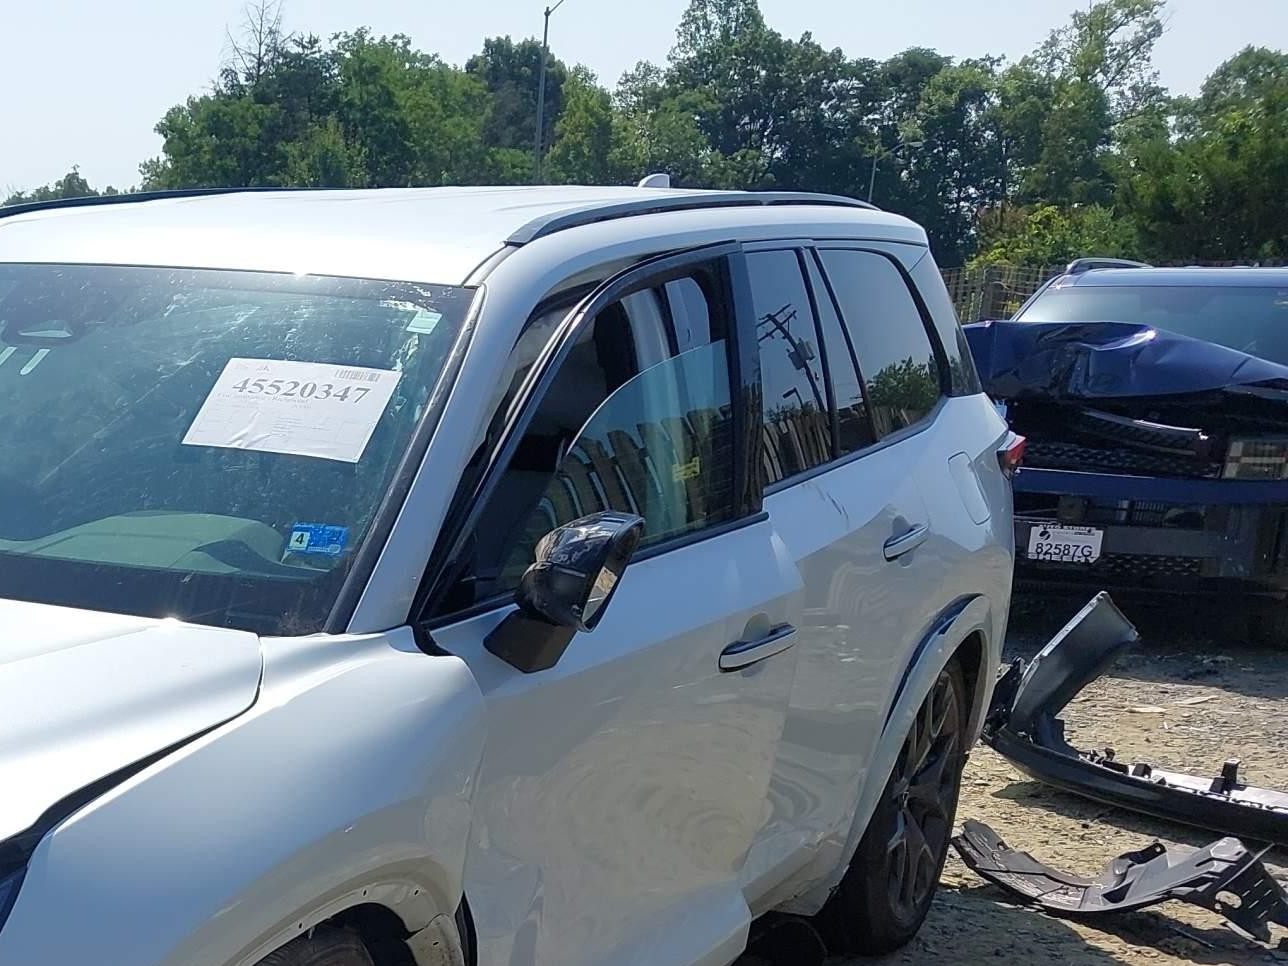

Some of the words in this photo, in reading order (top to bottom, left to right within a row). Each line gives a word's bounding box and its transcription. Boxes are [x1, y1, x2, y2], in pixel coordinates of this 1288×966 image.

[232, 377, 372, 404] 45520347
[294, 532, 305, 545] 4
[1035, 542, 1093, 558] 82587G
